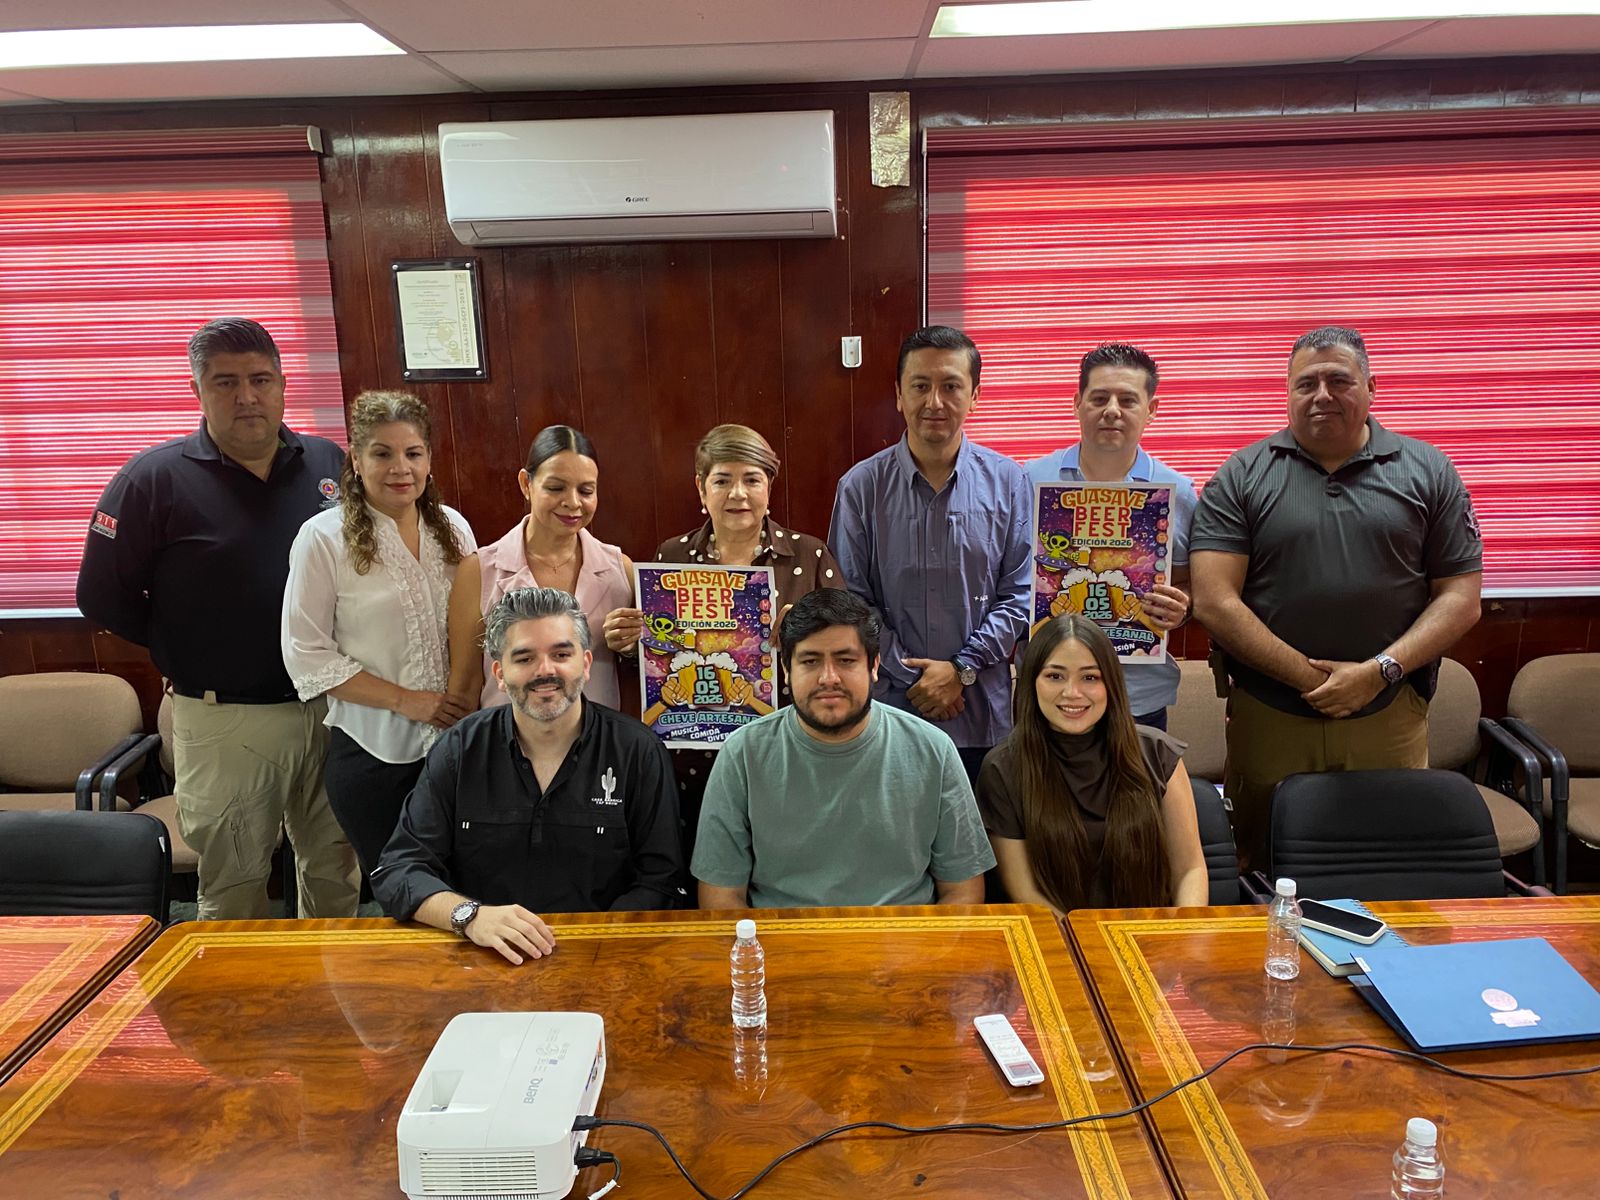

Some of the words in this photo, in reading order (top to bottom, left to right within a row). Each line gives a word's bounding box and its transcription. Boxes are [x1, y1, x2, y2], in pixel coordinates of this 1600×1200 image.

[1062, 489, 1147, 508] GUASAVE
[1075, 506, 1131, 521] BEER
[1074, 522, 1130, 537] FEST
[1071, 537, 1107, 546] EDICIÓN
[661, 570, 746, 589] GUASAVE
[678, 588, 733, 603] BEER
[1088, 583, 1107, 597] 16
[678, 603, 733, 619] FEST
[1085, 598, 1110, 611] 05
[1083, 611, 1113, 620] 2026
[675, 619, 712, 628] EDICIÓN
[713, 620, 737, 628] 2026
[1103, 628, 1153, 641] TESANAL
[697, 666, 715, 680] 16
[695, 680, 720, 694] 05
[694, 694, 724, 704] 2026
[660, 713, 696, 724] CHEVE
[698, 713, 757, 724] ARTESAN
[523, 1078, 544, 1105] BenQ
